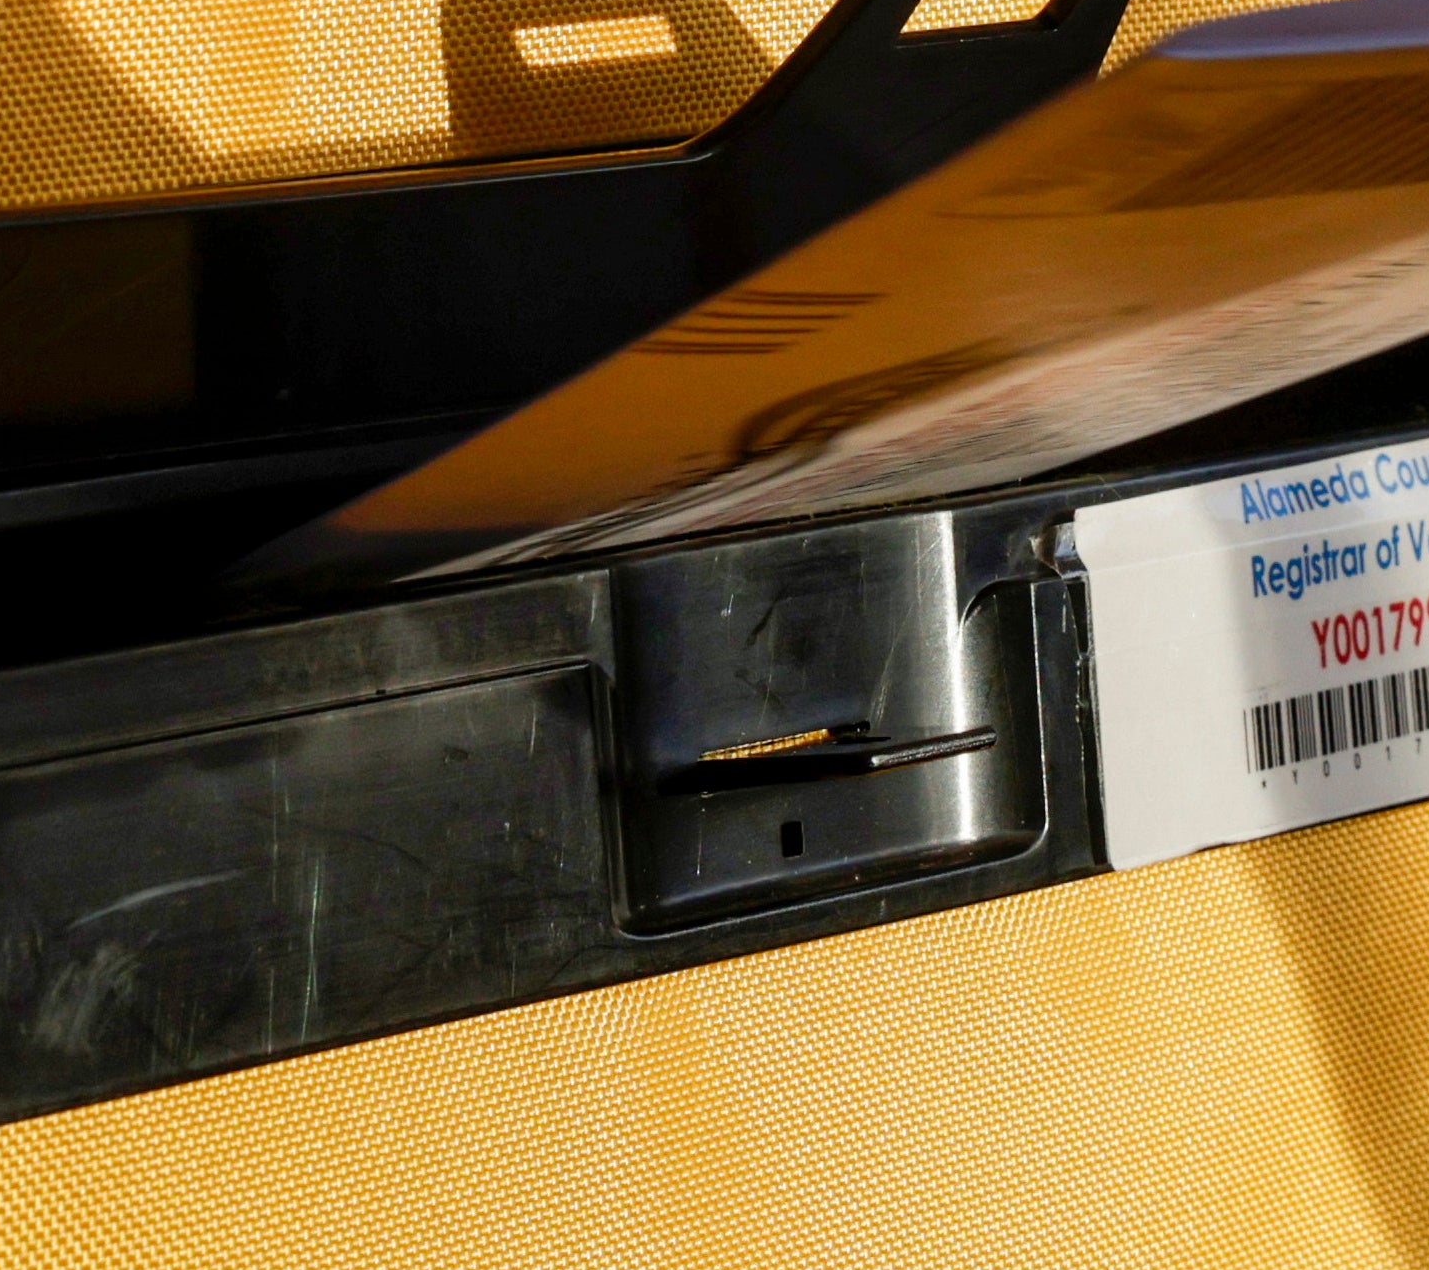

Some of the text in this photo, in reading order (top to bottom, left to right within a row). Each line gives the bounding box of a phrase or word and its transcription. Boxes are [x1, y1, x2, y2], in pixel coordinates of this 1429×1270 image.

[1240, 462, 1370, 524] Alameda
[1250, 540, 1367, 600] Registrar
[1375, 525, 1400, 569] of
